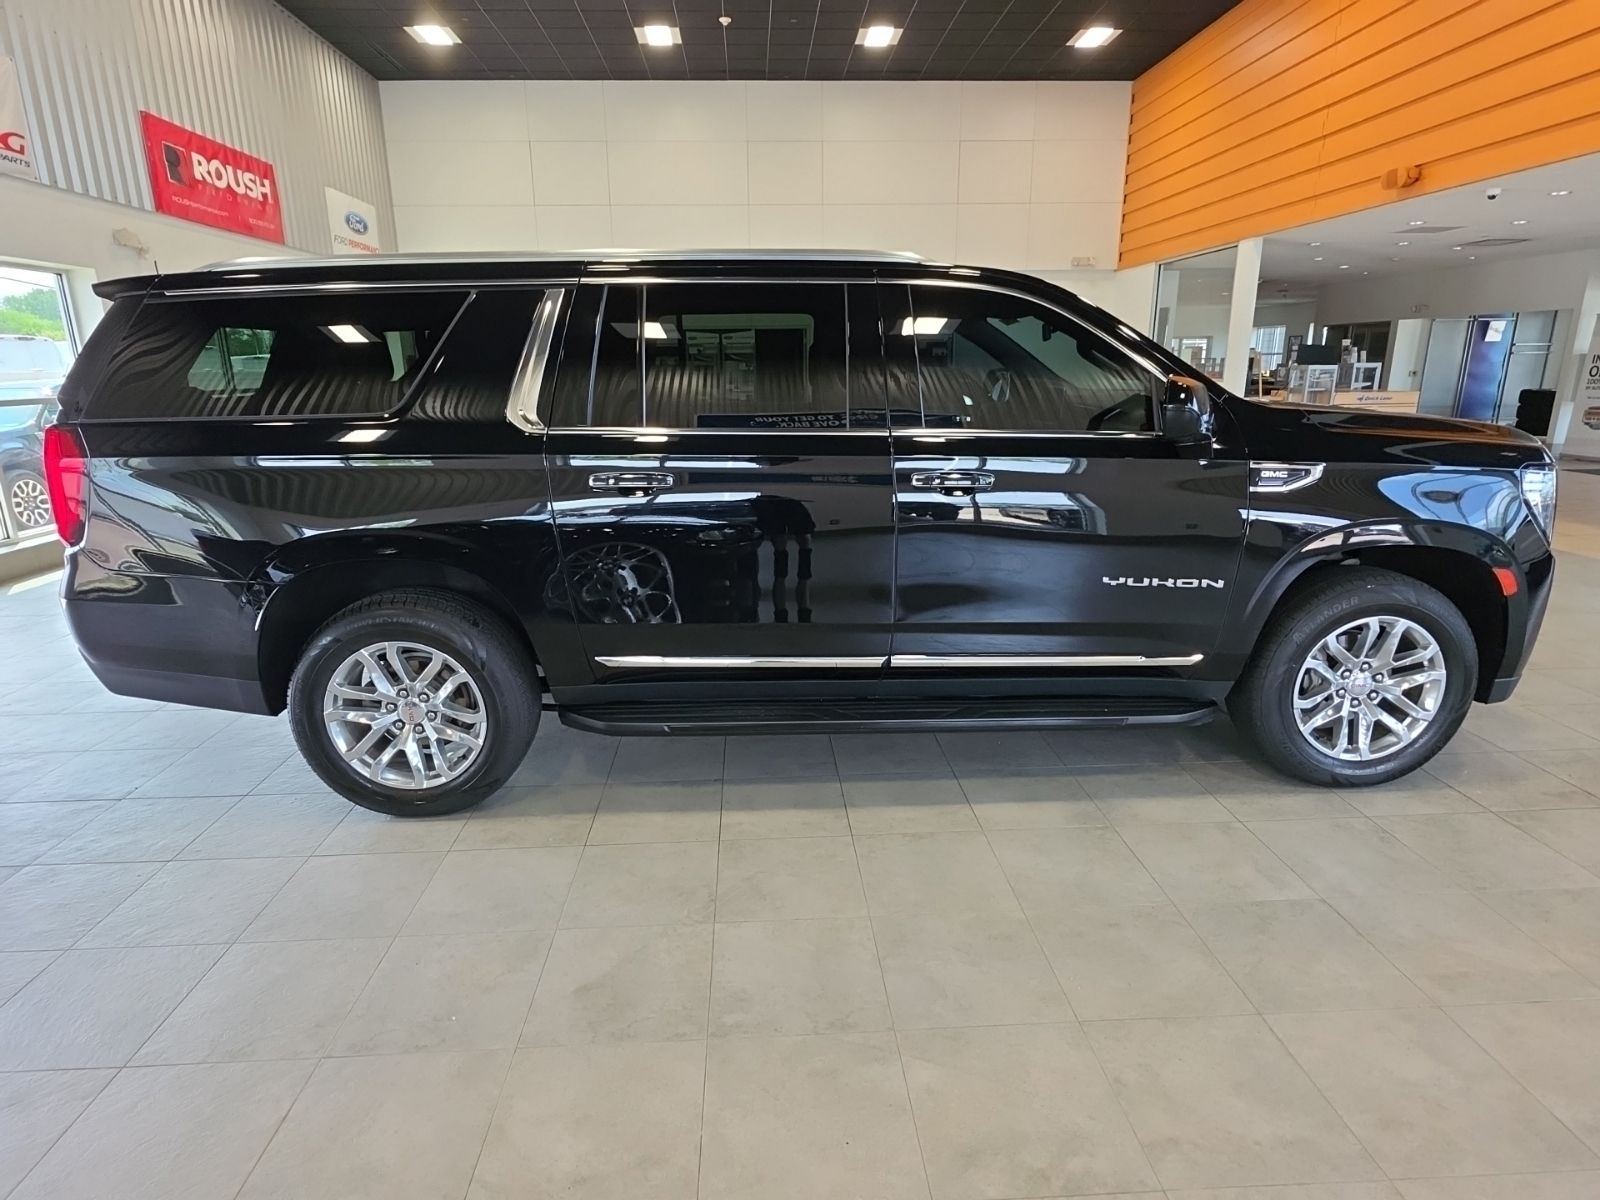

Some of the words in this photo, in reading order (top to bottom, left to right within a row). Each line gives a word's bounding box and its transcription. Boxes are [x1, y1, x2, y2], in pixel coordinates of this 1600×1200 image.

[191, 151, 273, 204] ROUSH
[348, 213, 365, 233] Ford
[348, 239, 380, 256] PERFORMANC
[1102, 577, 1225, 589] YUKON
